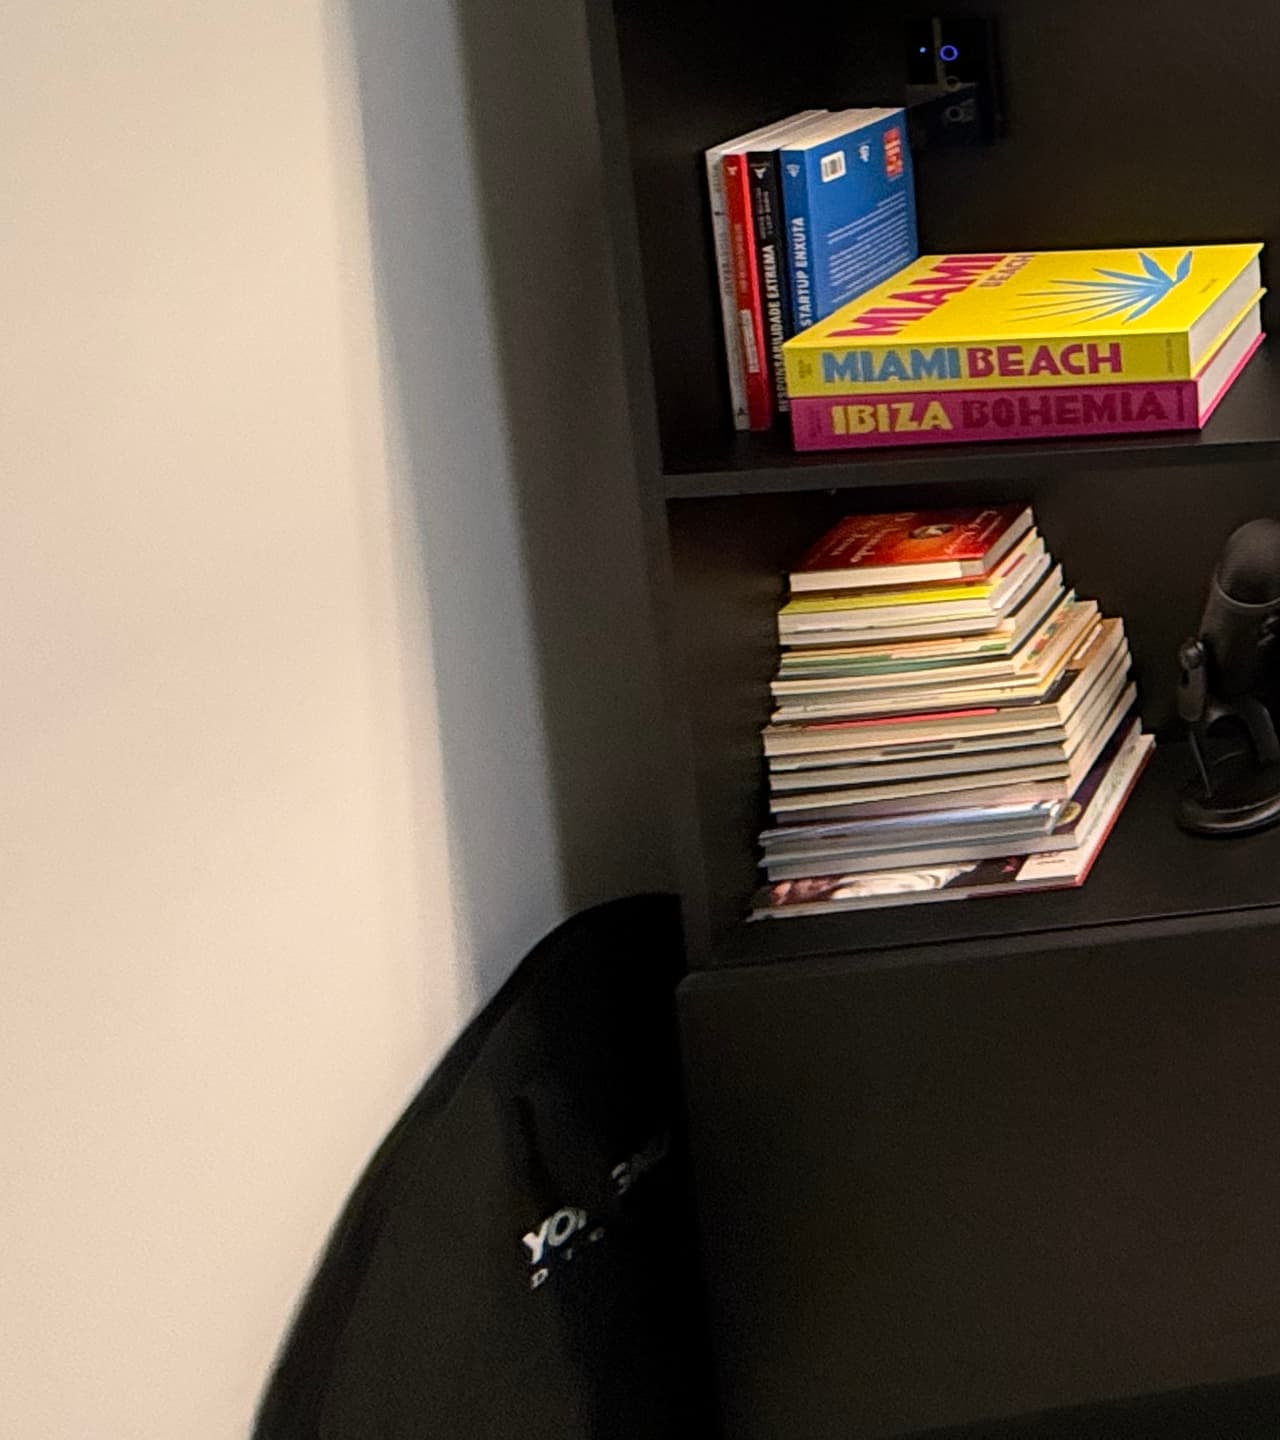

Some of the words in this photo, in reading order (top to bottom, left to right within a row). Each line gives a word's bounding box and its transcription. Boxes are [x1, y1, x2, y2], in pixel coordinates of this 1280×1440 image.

[792, 216, 809, 268] ENXUTA
[762, 244, 780, 298] EXTREMA
[826, 254, 1008, 338] MIAMI
[977, 254, 1036, 288] BEACH
[797, 274, 813, 327] STARTUP
[822, 346, 962, 384] MIAMI
[967, 342, 1123, 380] BEACH
[831, 401, 953, 435] IBIZA
[961, 386, 1169, 429] BOHEMIA
